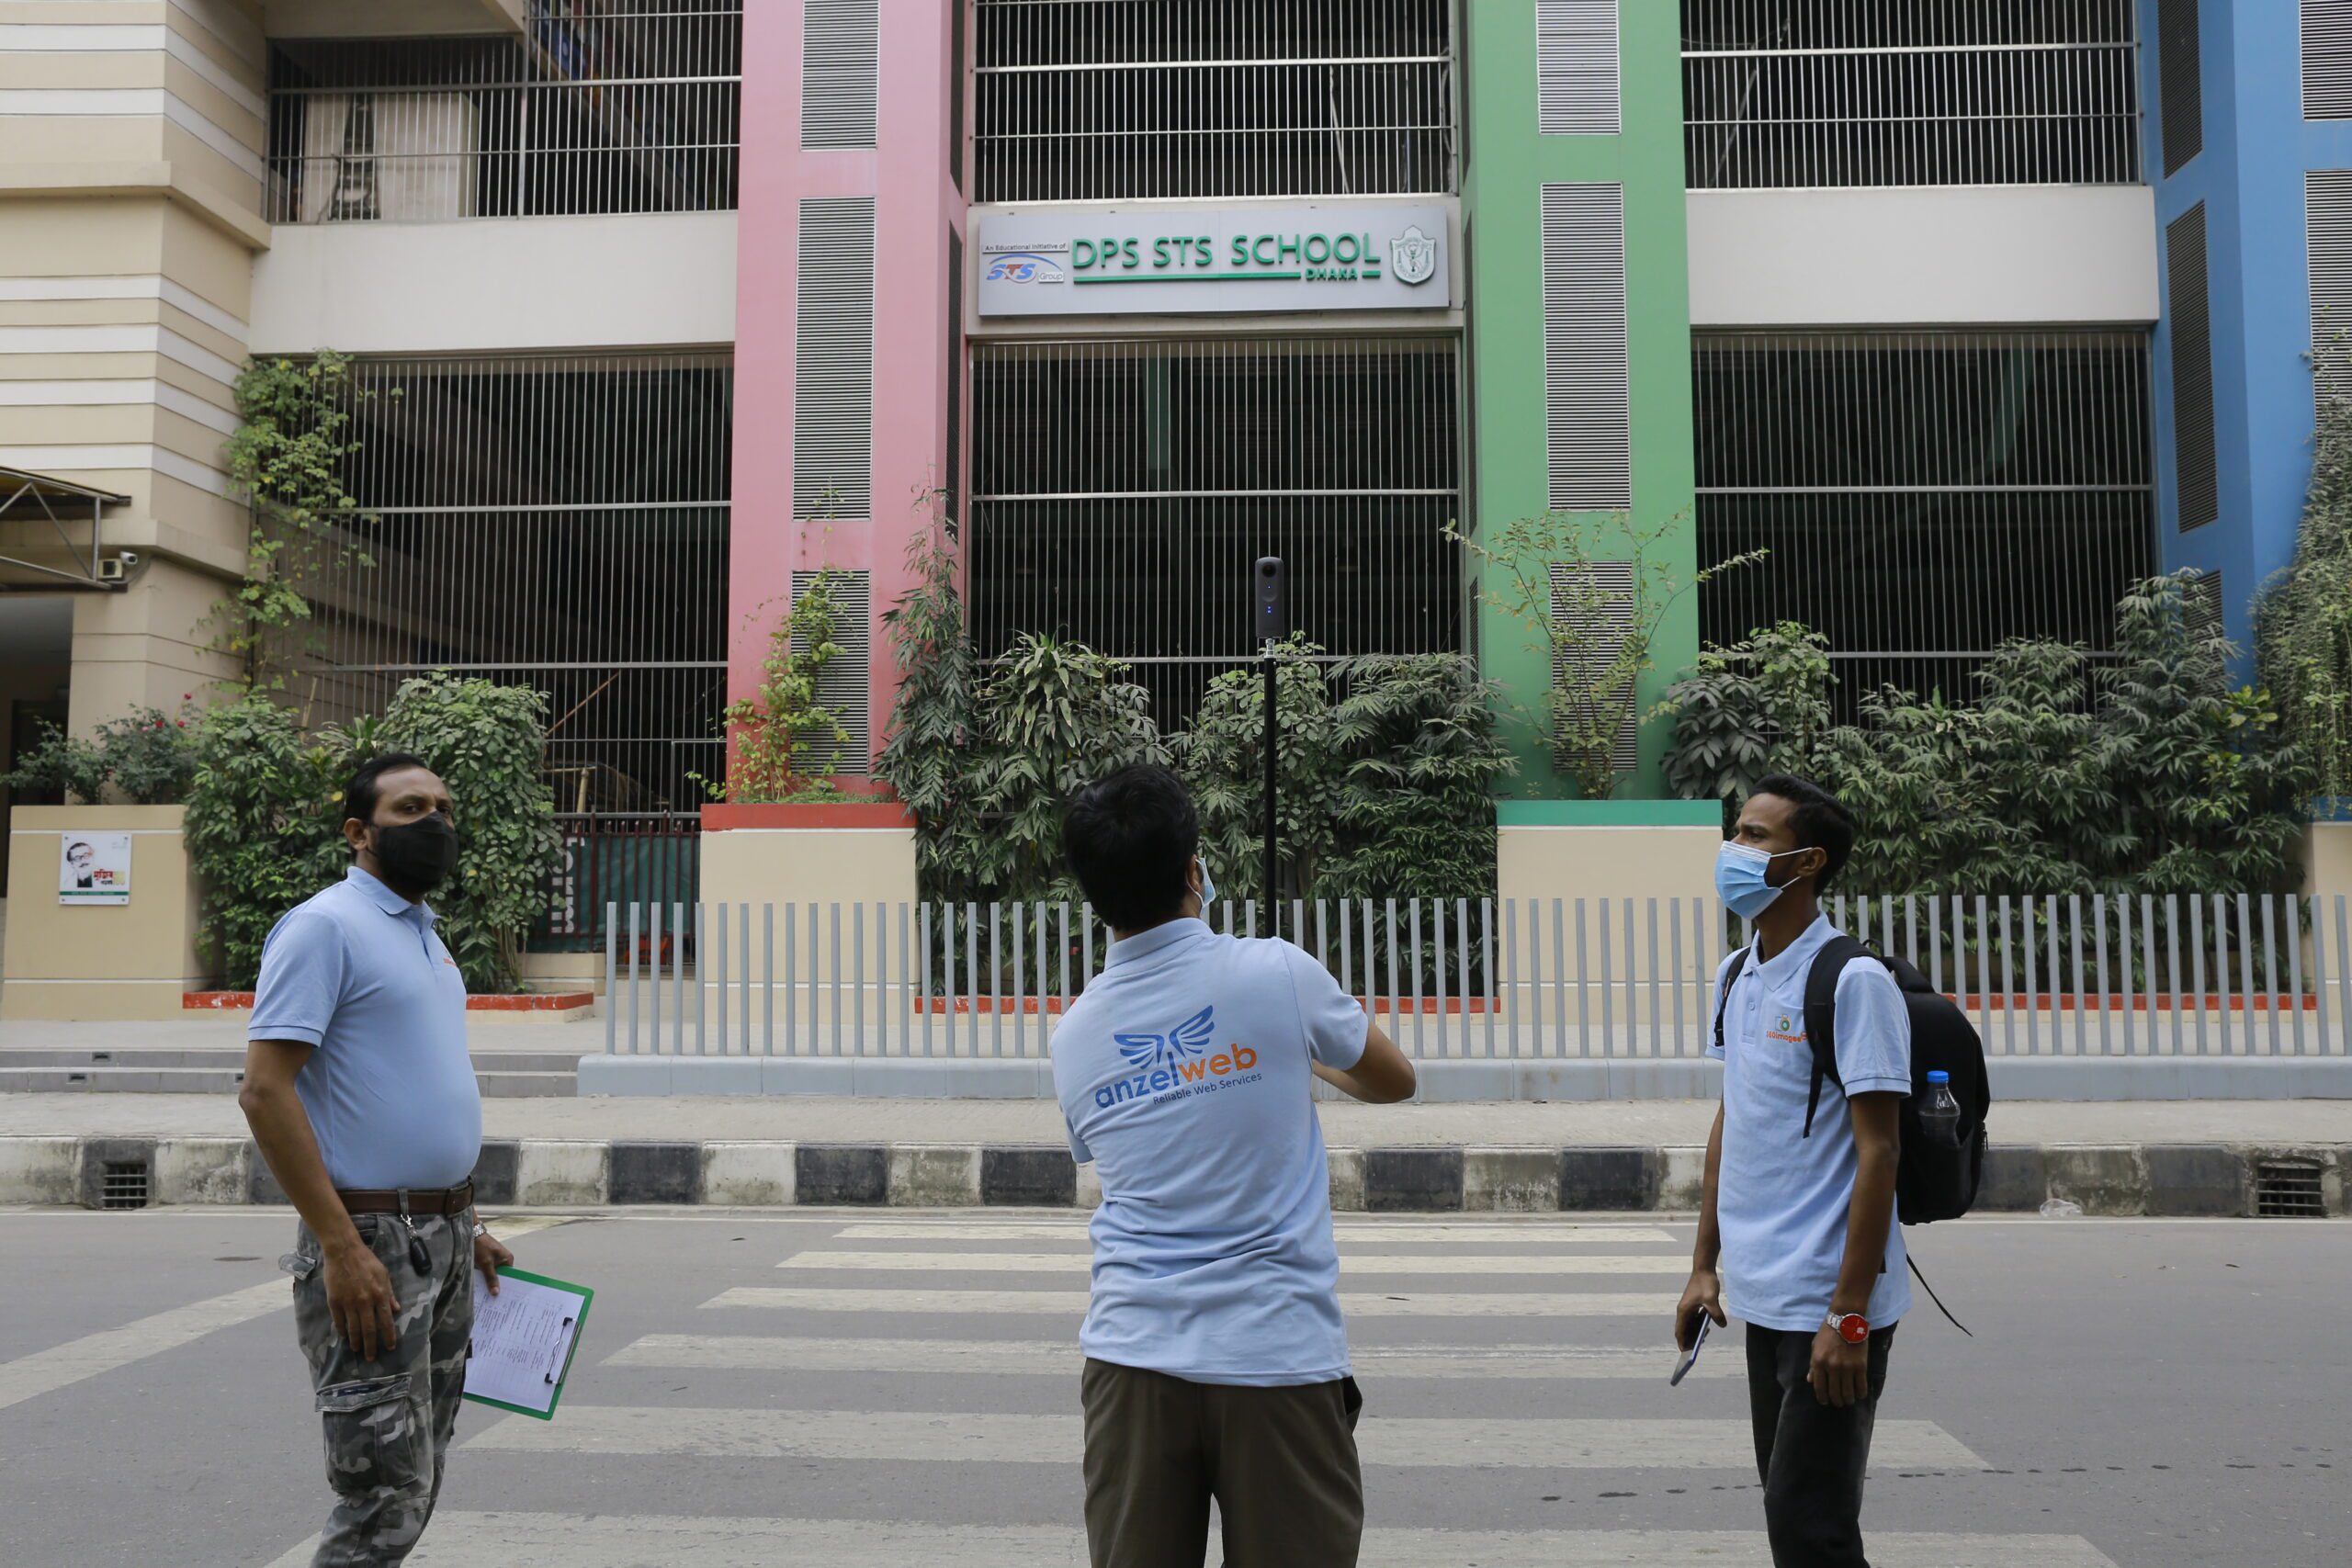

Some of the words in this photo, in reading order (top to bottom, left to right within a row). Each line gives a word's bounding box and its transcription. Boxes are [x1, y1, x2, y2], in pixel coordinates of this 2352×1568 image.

[1073, 237, 1139, 268] DPS
[1153, 236, 1213, 266] STS
[1231, 233, 1381, 265] SCHOOL
[987, 264, 1036, 280] STS
[1039, 273, 1063, 281] Group
[1306, 268, 1358, 280] DHAKA
[1095, 1043, 1258, 1108] anzelweb
[1153, 1089, 1192, 1105] Reliable
[1193, 1084, 1217, 1096] Web
[1219, 1073, 1262, 1089] Services
